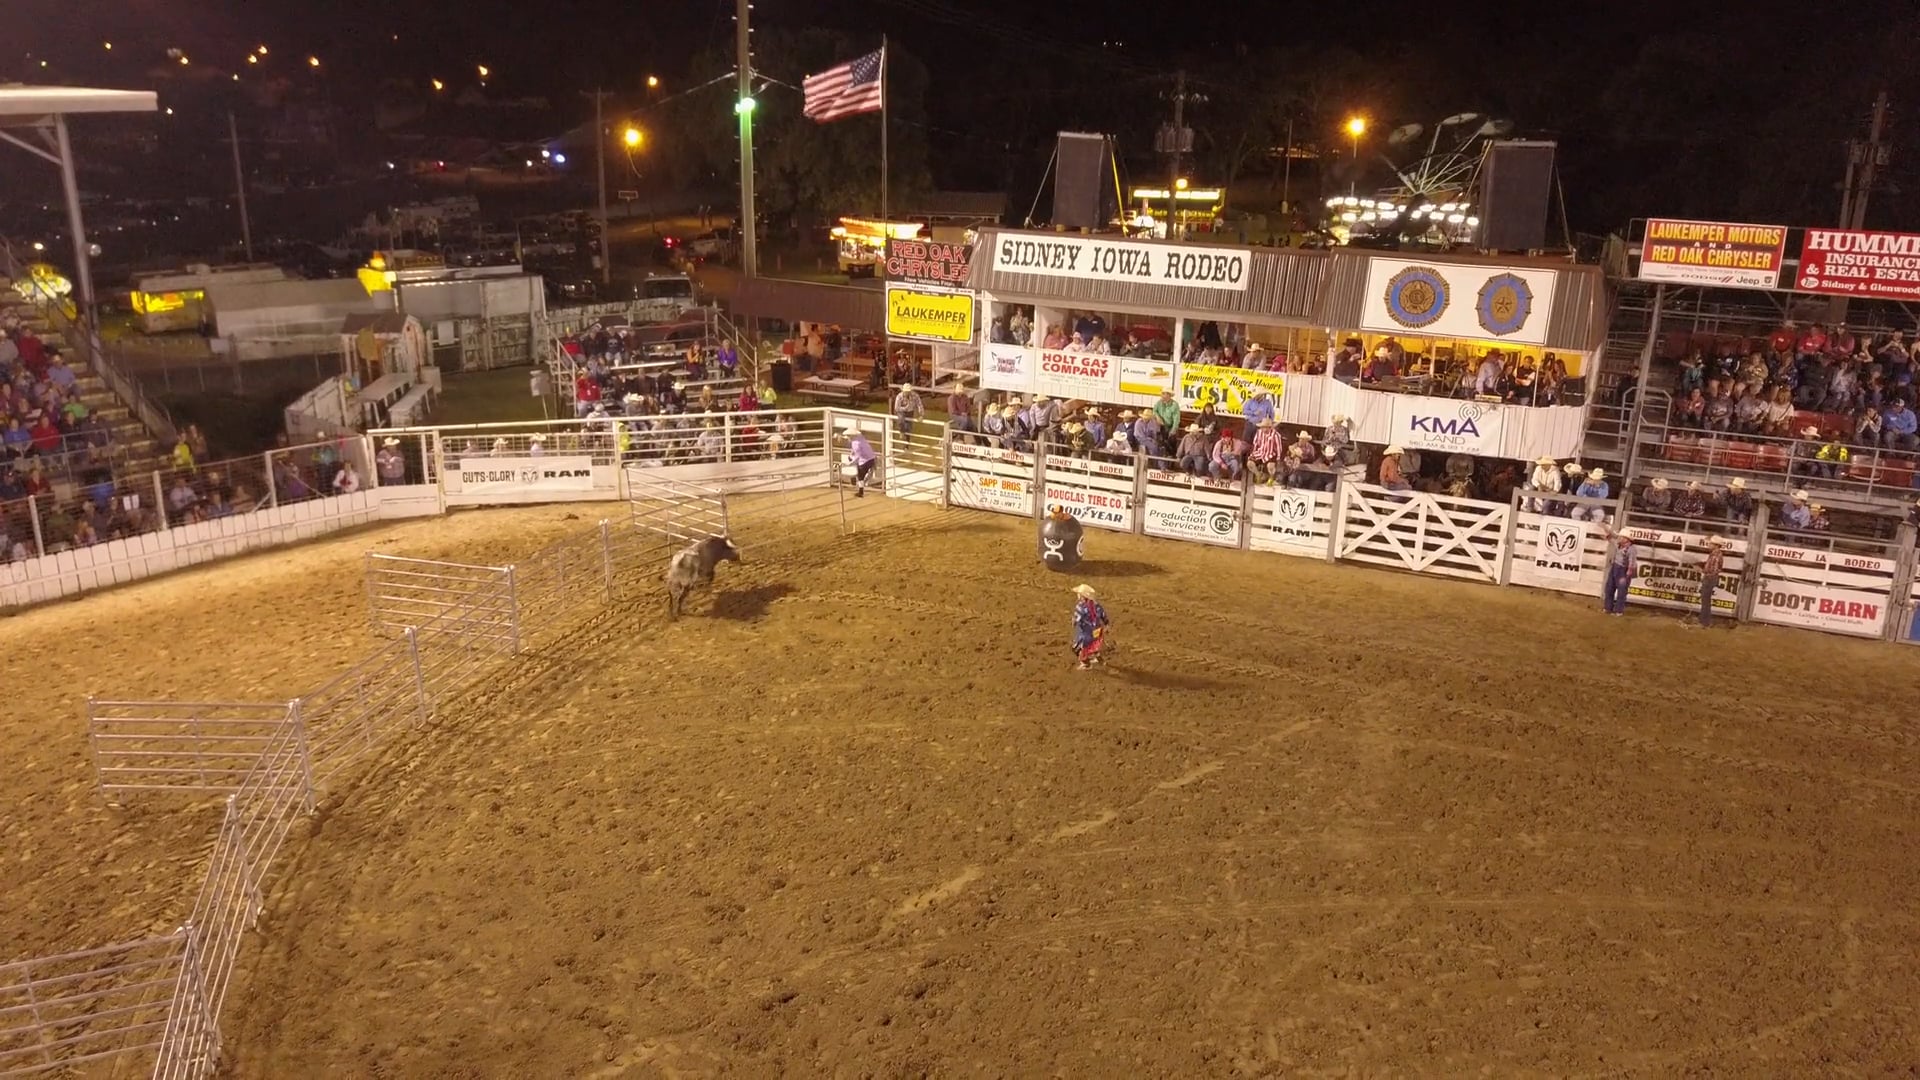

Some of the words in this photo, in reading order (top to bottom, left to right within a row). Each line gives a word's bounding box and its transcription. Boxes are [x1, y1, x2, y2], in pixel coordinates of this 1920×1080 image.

[1650, 222, 1725, 242] LAUKEMPER
[1727, 226, 1781, 246] MOTORS
[891, 240, 927, 260] RED
[929, 243, 966, 264] OAK
[1651, 245, 1677, 263] RED
[1679, 247, 1705, 264] OAK
[1707, 249, 1772, 269] CHRYSLER
[1000, 238, 1082, 271] SIDNEY
[1091, 246, 1152, 277] IOWA
[1164, 251, 1243, 284] RODEO
[1806, 263, 1820, 276] &
[1823, 264, 1870, 278] REAL
[1874, 267, 1920, 281] ESTA
[1736, 275, 1760, 286] Jeep
[1821, 279, 1856, 292] Sidney
[1858, 282, 1867, 290] &
[896, 305, 967, 324] LAUKEMPER
[1042, 353, 1077, 365] HOLT
[1081, 357, 1109, 369] GAS
[1042, 362, 1107, 378] COMPANY
[1183, 384, 1229, 405] KCSI
[1410, 415, 1480, 438] KMA
[1423, 433, 1466, 445] LAND
[953, 444, 976, 453] SIDNEY
[544, 470, 591, 478] RAM
[1048, 457, 1073, 467] SIDNEY
[1099, 465, 1124, 475] RODEO
[979, 477, 998, 488] SAPP
[1149, 472, 1176, 481] SIDNEY
[1047, 488, 1085, 503] DOUGLAS
[1088, 494, 1107, 508] TIRE
[1109, 498, 1124, 510] CO.
[1149, 509, 1207, 524] Production
[1181, 505, 1207, 516] Crop
[1161, 518, 1206, 532] Services
[1272, 525, 1310, 538] RAM
[1536, 559, 1580, 572] RAM
[1767, 548, 1805, 560] SIDNEY
[1844, 558, 1881, 569] RODEO
[1758, 590, 1816, 611] BOOT
[1818, 598, 1878, 620] BARN
